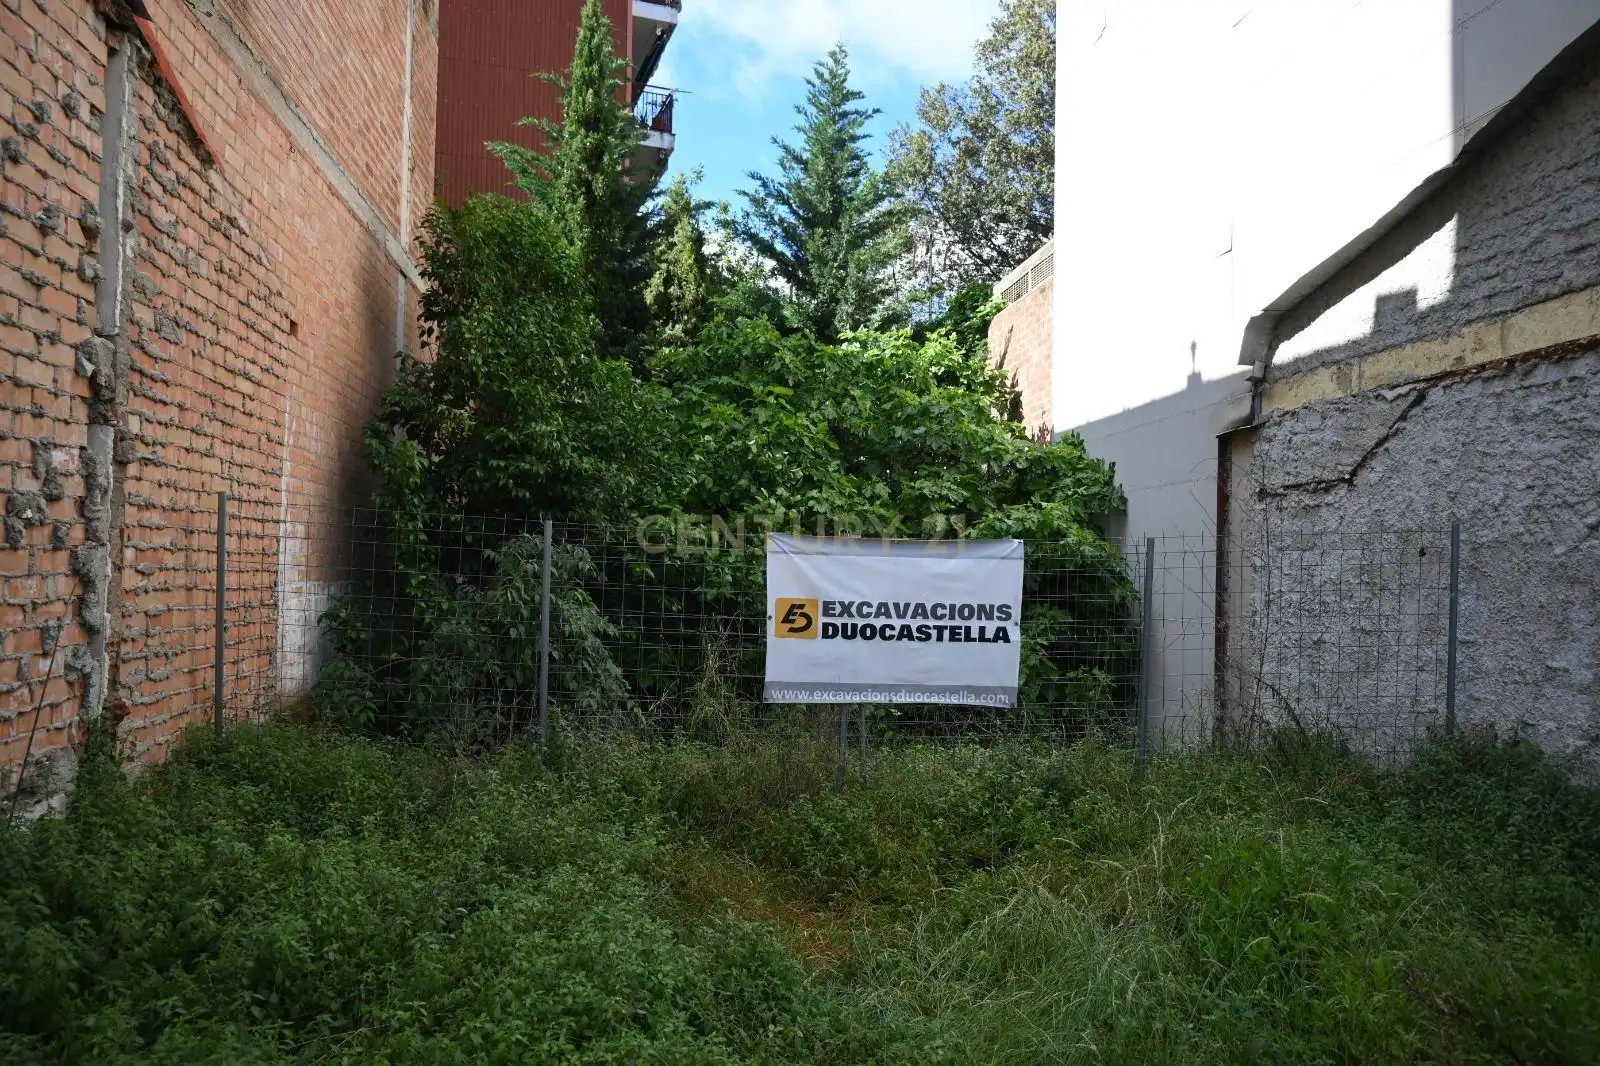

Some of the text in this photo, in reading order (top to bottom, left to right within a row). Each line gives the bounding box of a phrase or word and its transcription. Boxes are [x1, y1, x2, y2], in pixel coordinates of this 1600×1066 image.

[821, 600, 1013, 622] EXCAVACIONS
[821, 622, 1011, 644] DUOCASTELLA
[771, 687, 1010, 705] www.excavacionsduocastella.com
